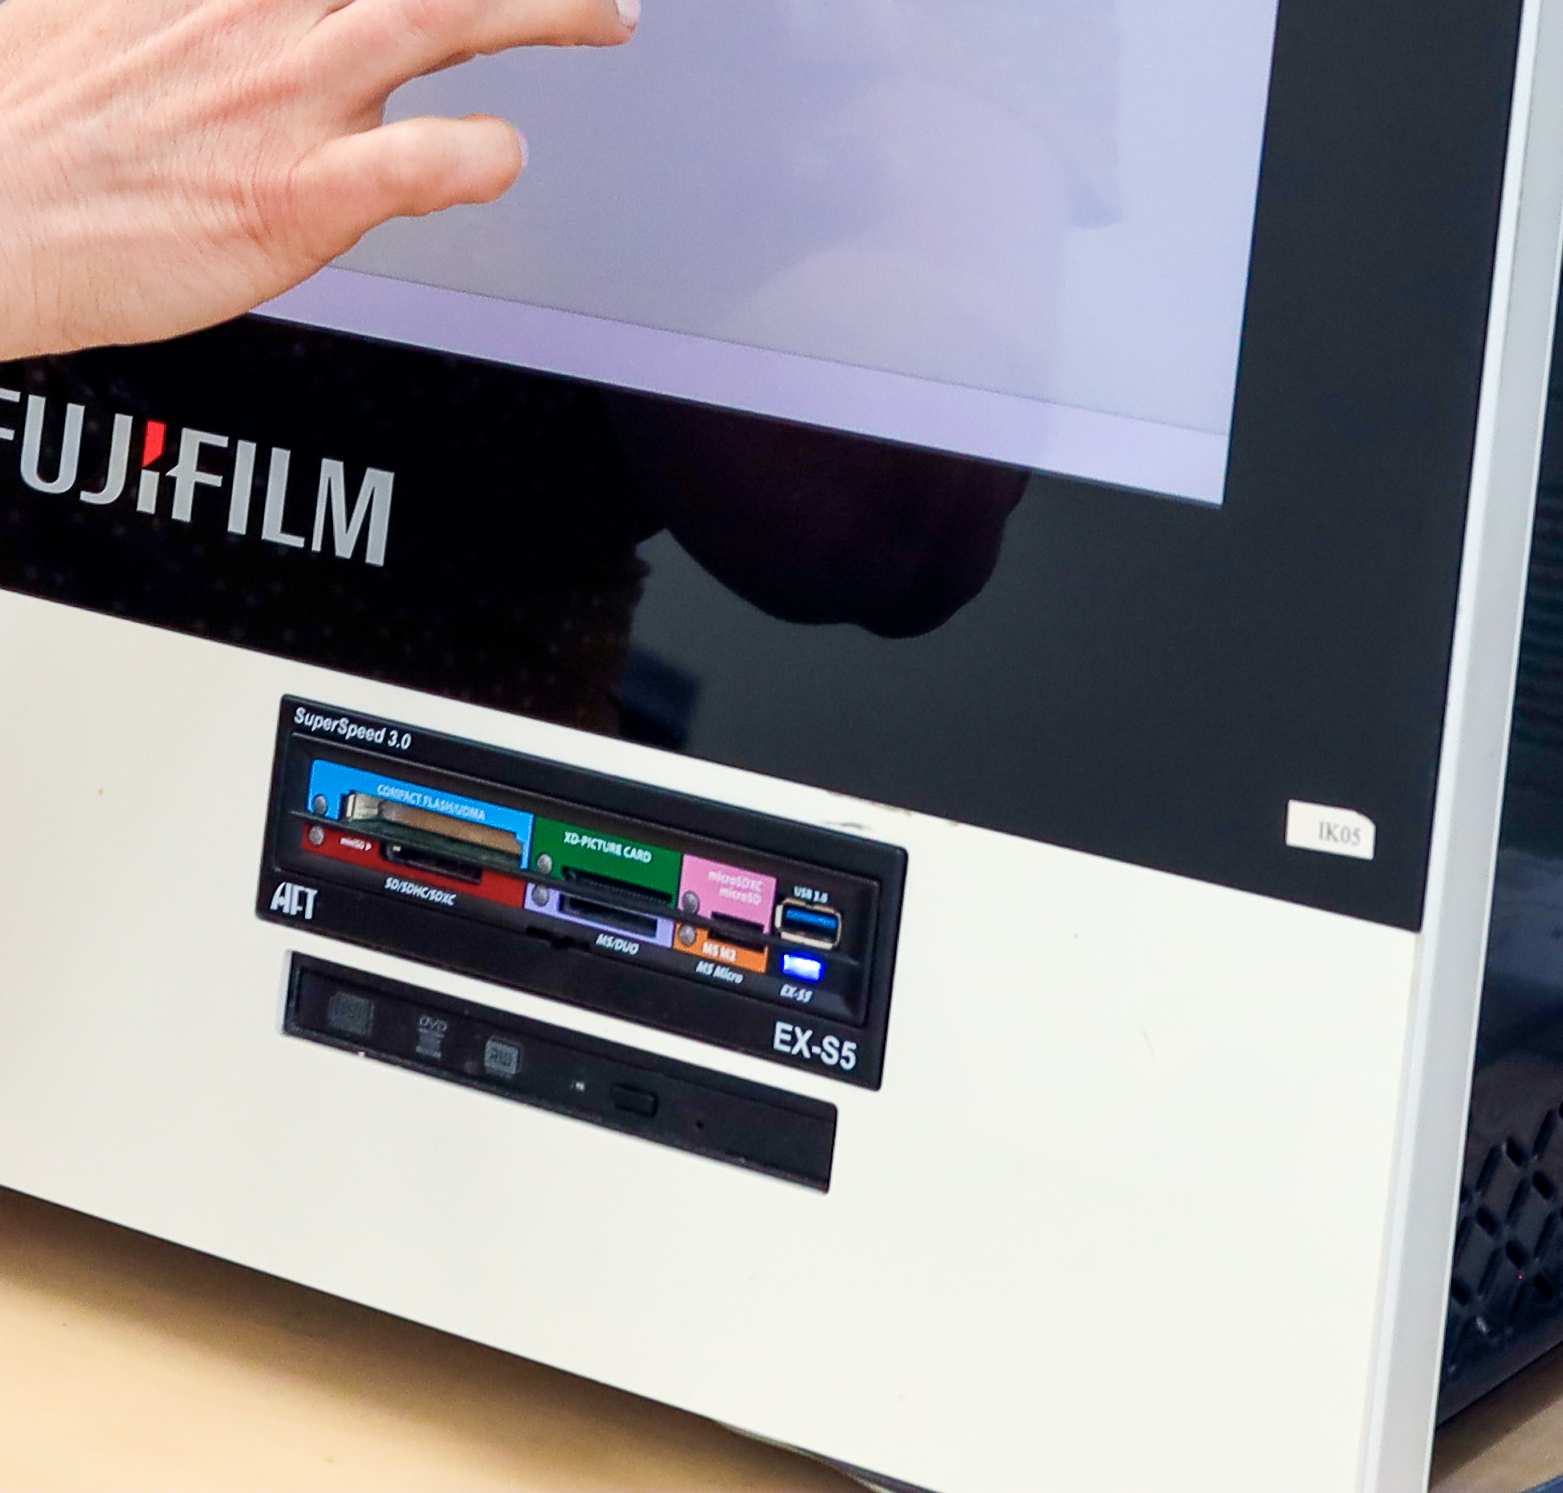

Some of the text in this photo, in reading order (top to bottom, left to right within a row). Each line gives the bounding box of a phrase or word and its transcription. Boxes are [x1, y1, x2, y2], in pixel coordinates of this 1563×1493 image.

[294, 706, 412, 750] SuperSpeed 3.0
[377, 784, 422, 806] COMPACT
[564, 831, 652, 864] XD-PICTURE CARD
[793, 885, 813, 901] USB
[596, 933, 640, 956] MS/DUO
[702, 941, 720, 958] MS
[695, 959, 744, 984] MS Micro
[773, 1021, 857, 1070] EX-S5
